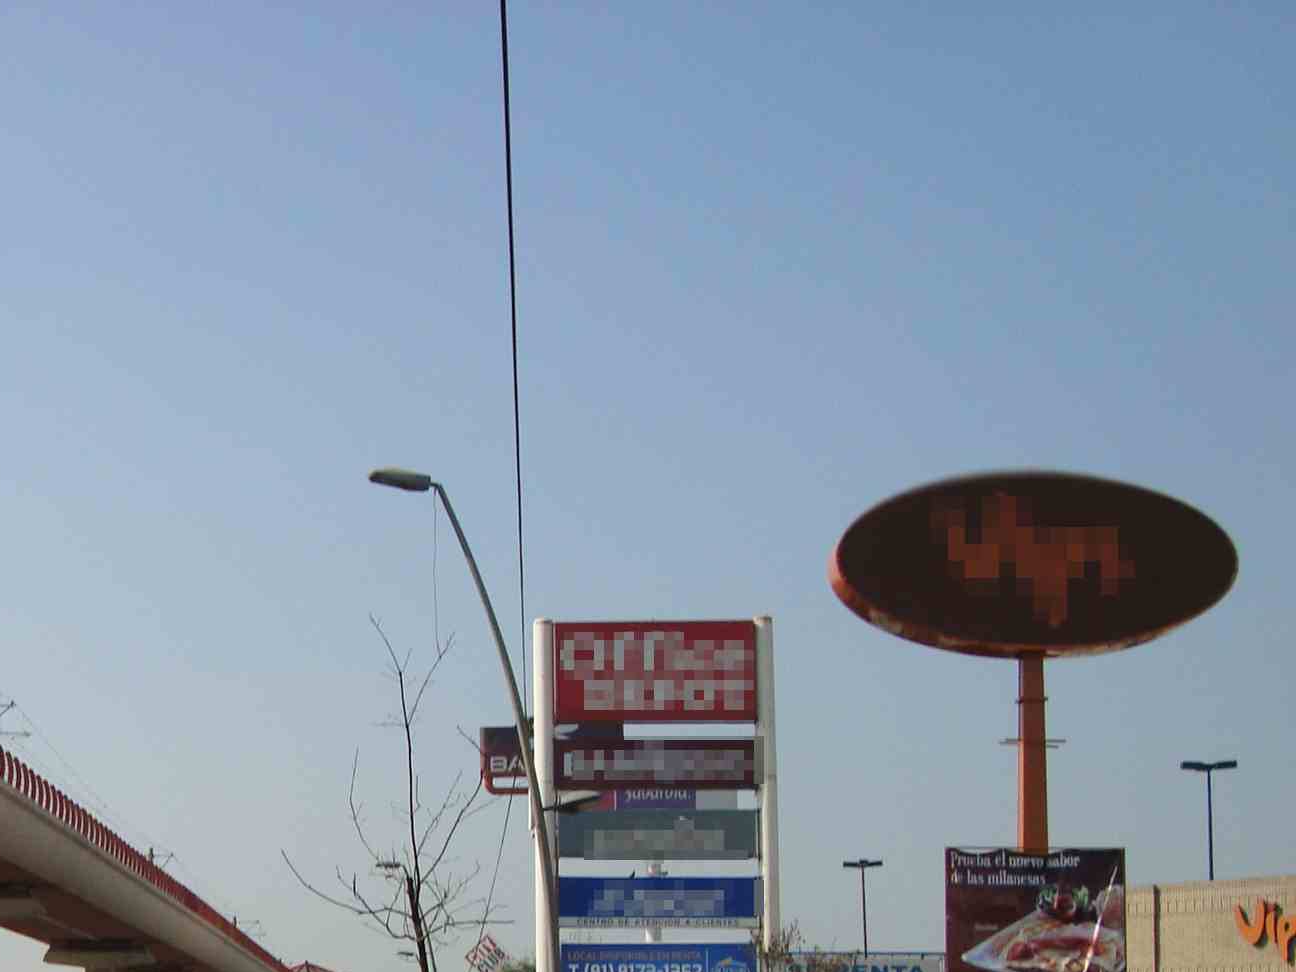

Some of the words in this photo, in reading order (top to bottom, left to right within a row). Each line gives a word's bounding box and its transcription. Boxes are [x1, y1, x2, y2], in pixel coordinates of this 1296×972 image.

[951, 852, 992, 868] Prueba
[995, 852, 1005, 867] el
[1008, 854, 1044, 867] nuevo
[1046, 853, 1081, 867] sabor
[967, 870, 985, 885] las
[988, 870, 1046, 886] milanesas
